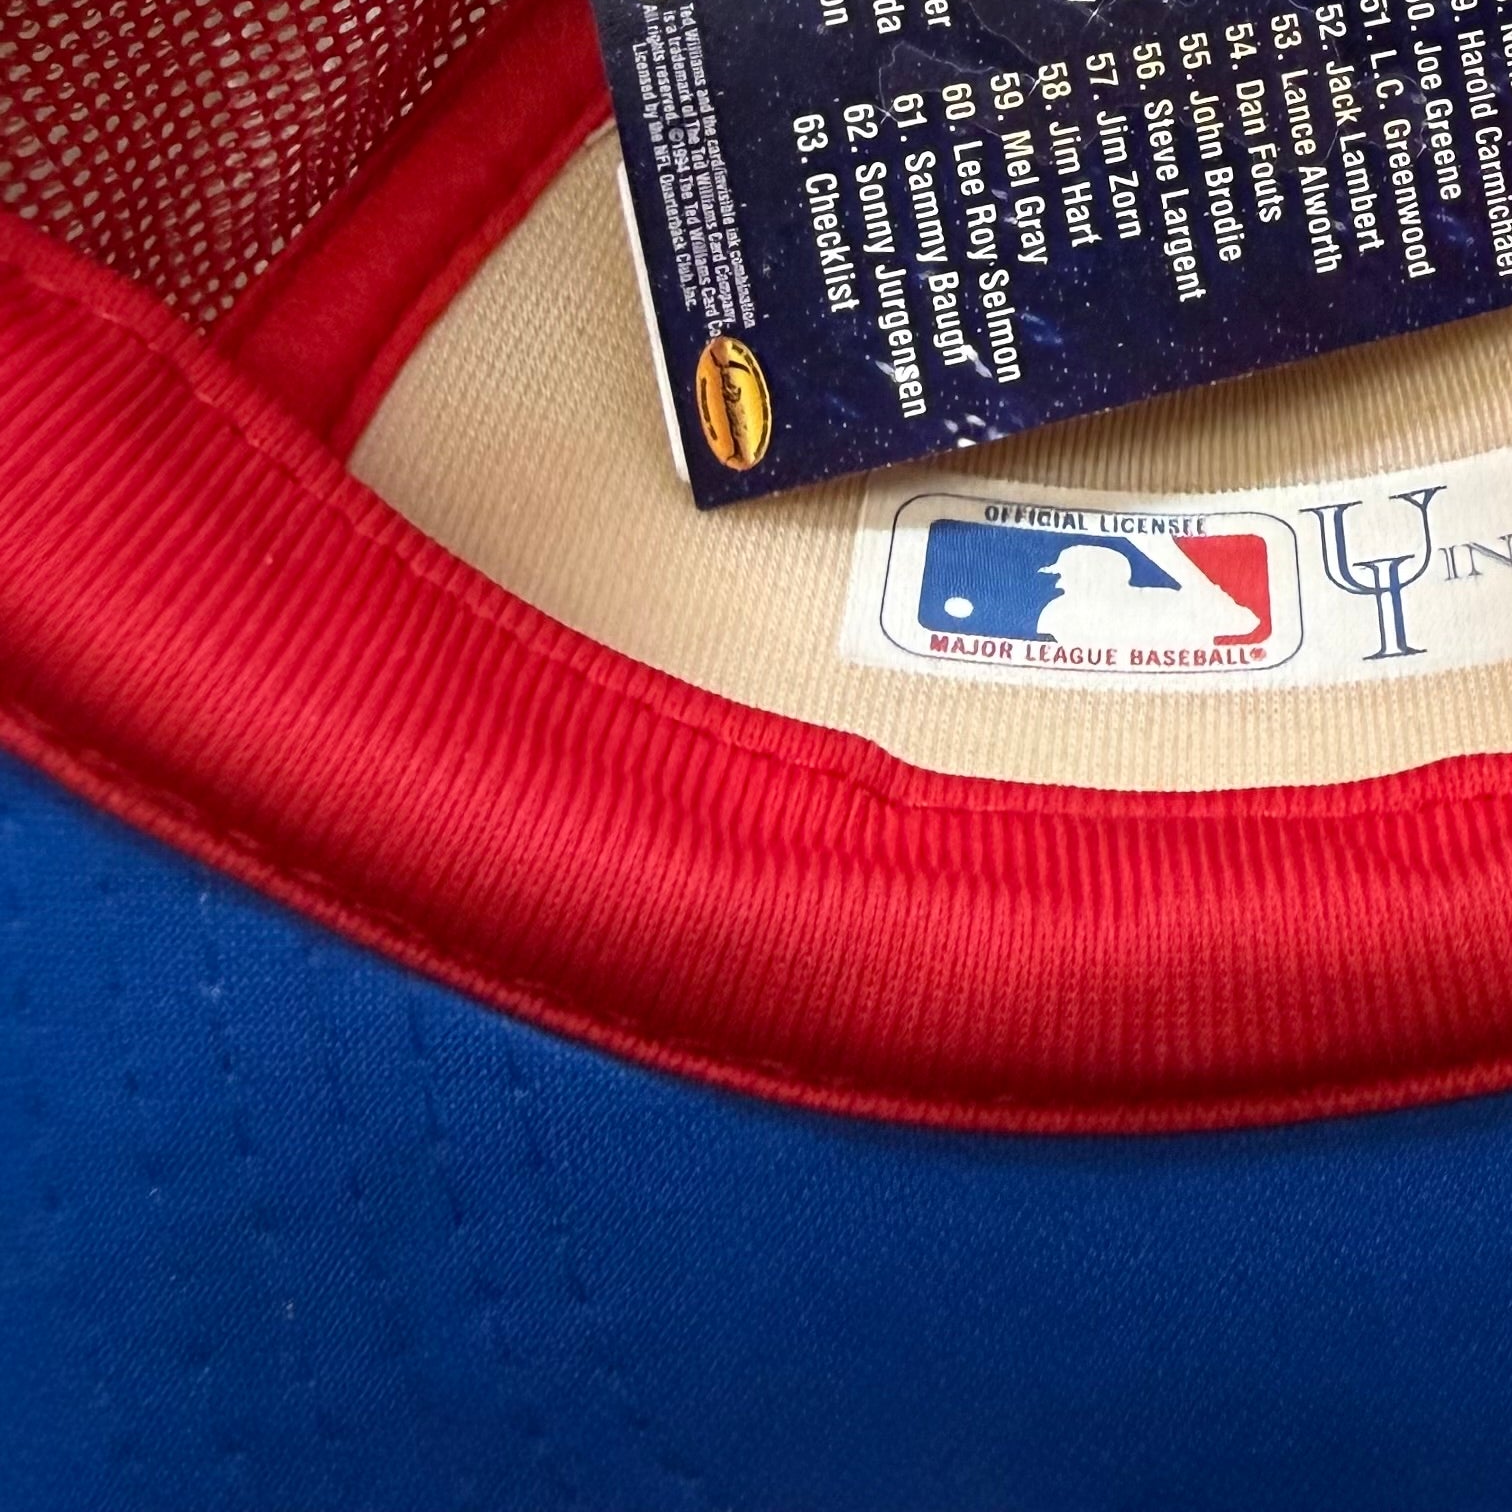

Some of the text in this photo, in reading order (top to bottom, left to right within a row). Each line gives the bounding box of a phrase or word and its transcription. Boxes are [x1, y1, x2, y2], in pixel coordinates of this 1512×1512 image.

[891, 92, 928, 142] 61.
[1037, 60, 1102, 248] 58. Jim Hart
[1084, 51, 1142, 239] 57. Jim Zorn
[1178, 31, 1245, 262] 55. John Brodie
[1224, 21, 1284, 223] 54. Dan Fouts
[1269, 12, 1343, 274] 53. Lance Alworth
[1314, 2, 1385, 253] 52. Jack Lambert
[1369, 48, 1404, 110] L.C.
[1412, 39, 1442, 90] Joe
[1424, 97, 1462, 200] Greene
[1456, 28, 1499, 120] Harold
[792, 113, 860, 313] 63. Checklist
[842, 102, 927, 419] 62. Sonny Jurgensen
[903, 149, 948, 262] Sammy
[940, 82, 1021, 383] 60. Lee Roy Selmon
[989, 71, 1048, 265] 59. Mel Gray
[1131, 41, 1207, 303] 56. Steve Largent
[1382, 117, 1436, 278] Greenwood
[985, 504, 1089, 532] OFFICIAL
[929, 633, 1013, 660] MAJOR
[1025, 644, 1119, 666] LEAGUE
